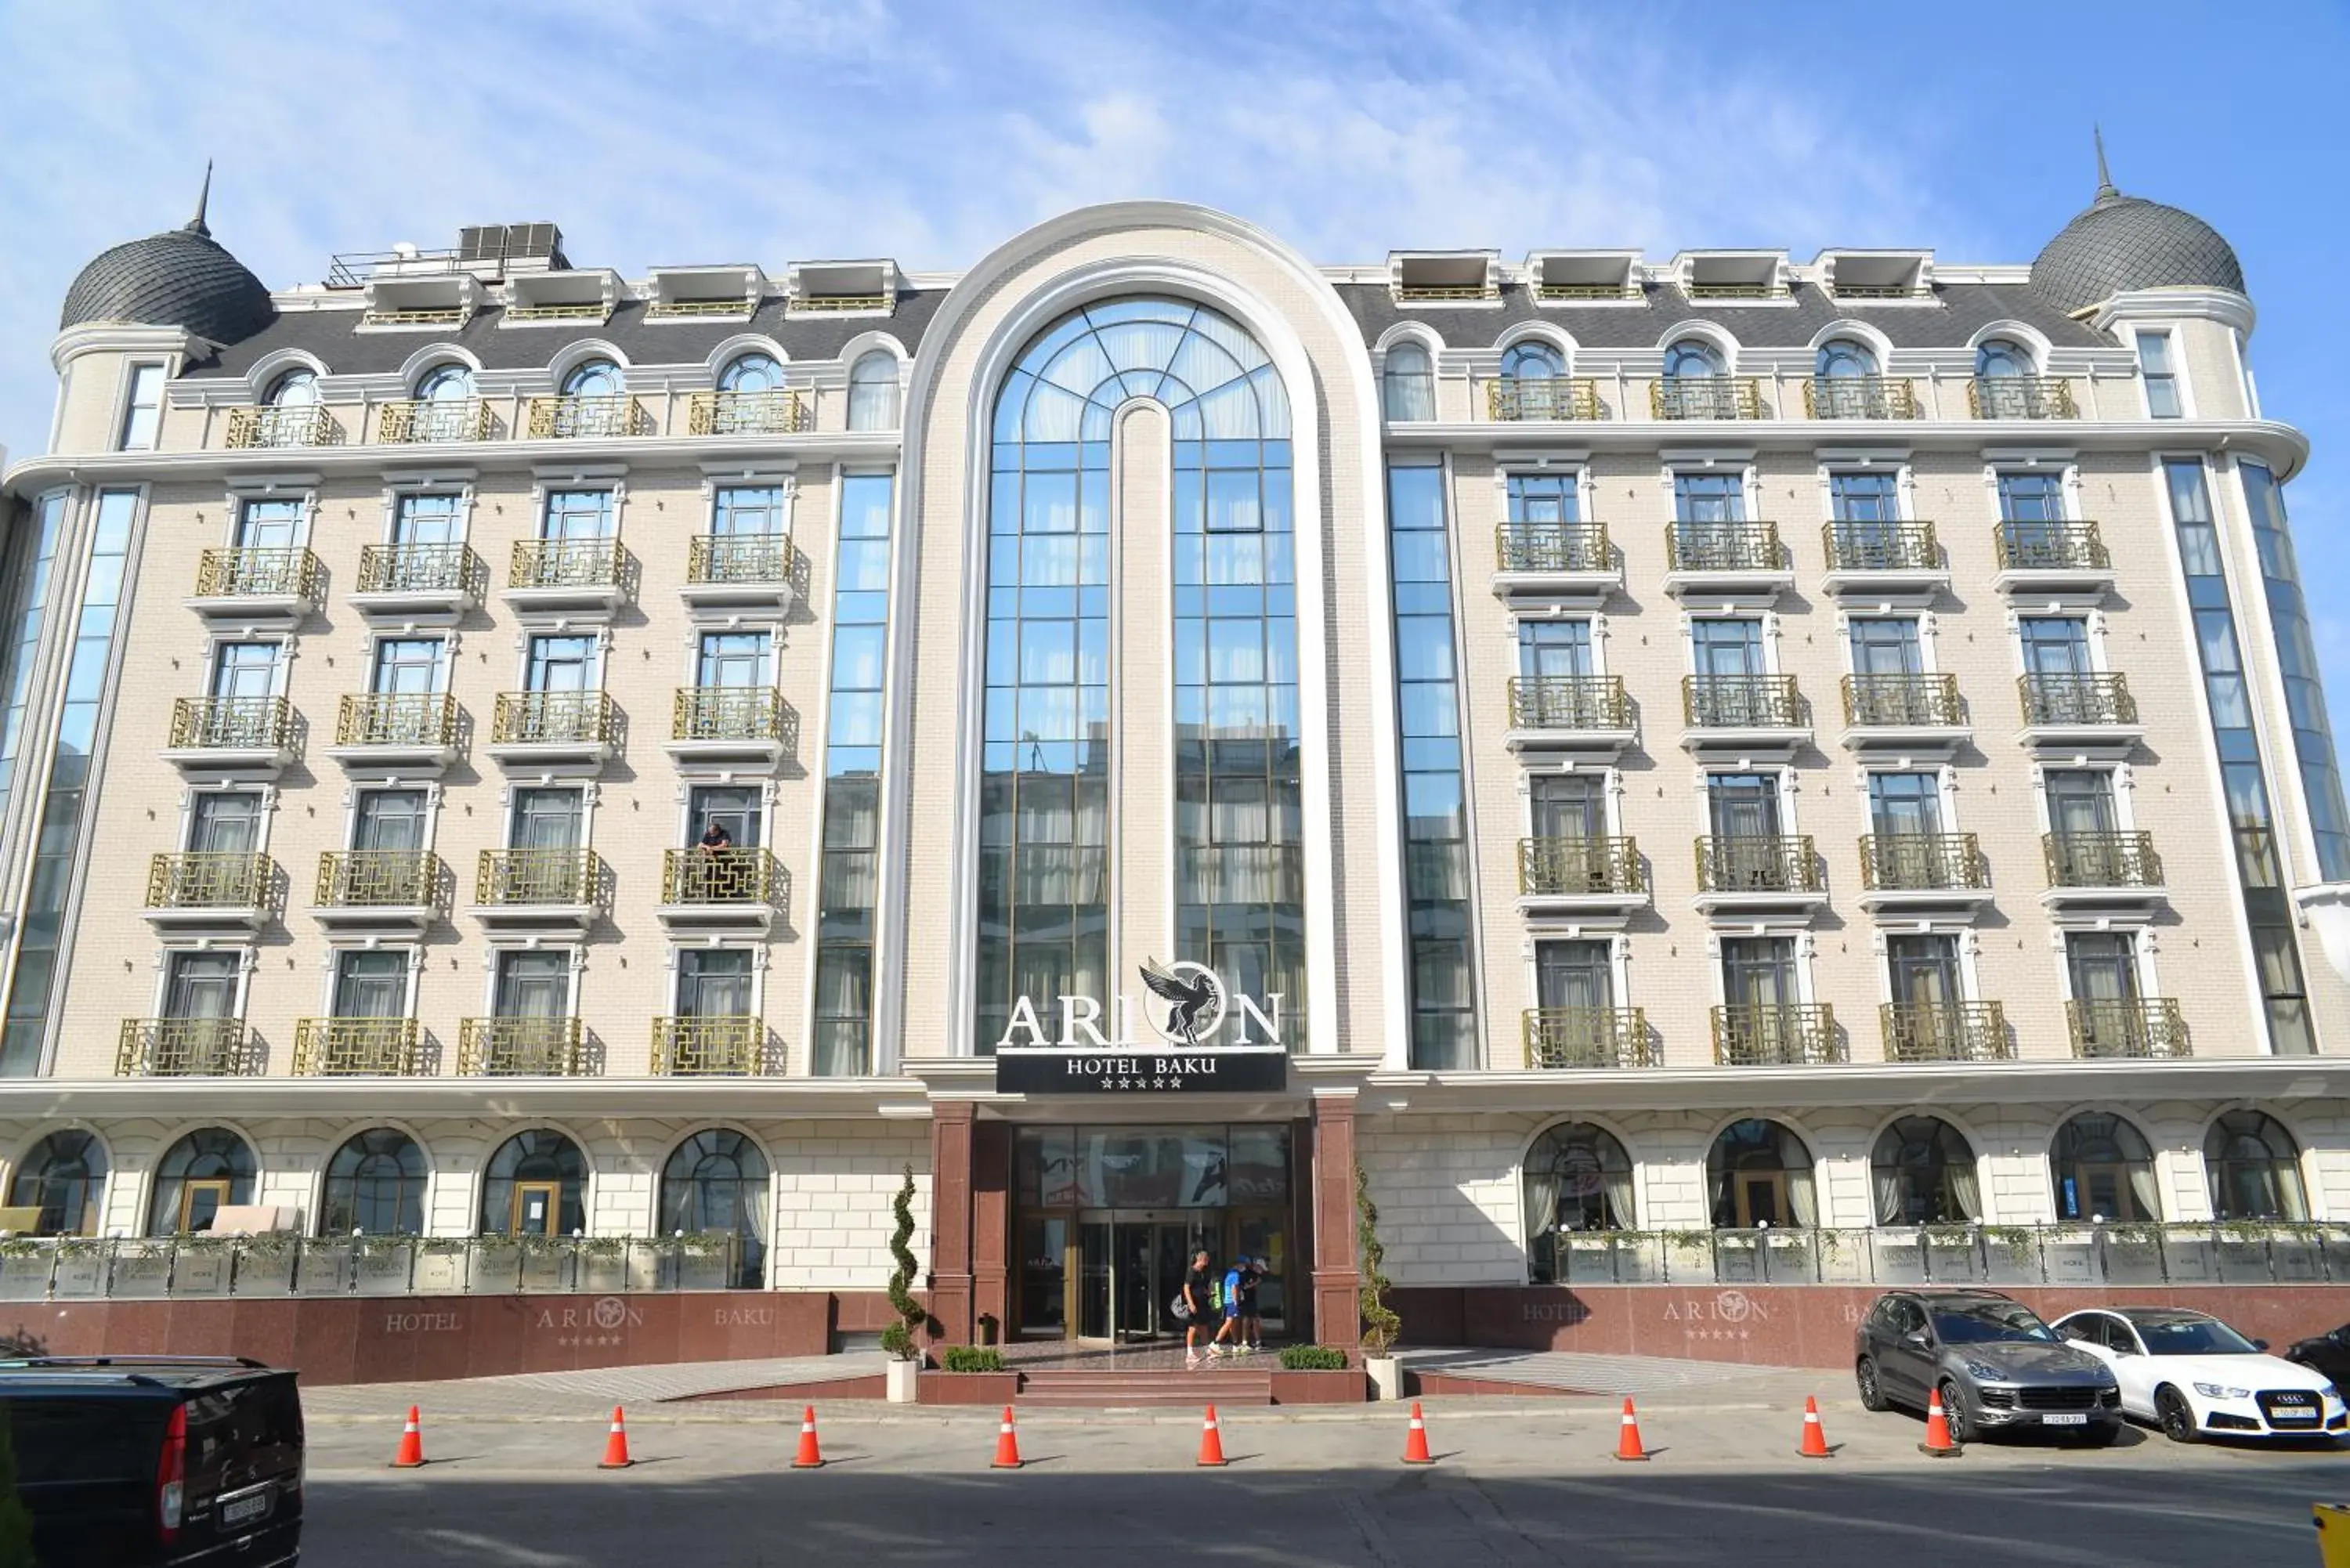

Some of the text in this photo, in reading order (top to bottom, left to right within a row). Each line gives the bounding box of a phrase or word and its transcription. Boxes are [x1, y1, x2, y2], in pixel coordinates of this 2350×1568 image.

[996, 961, 1285, 1046] ARION
[1067, 1057, 1217, 1074] HOTEL BAKU
[386, 1296, 775, 1332] HOTEL ARION BAKU
[1523, 1303, 1593, 1321] HOTEL
[1662, 1291, 1770, 1322] ARION
